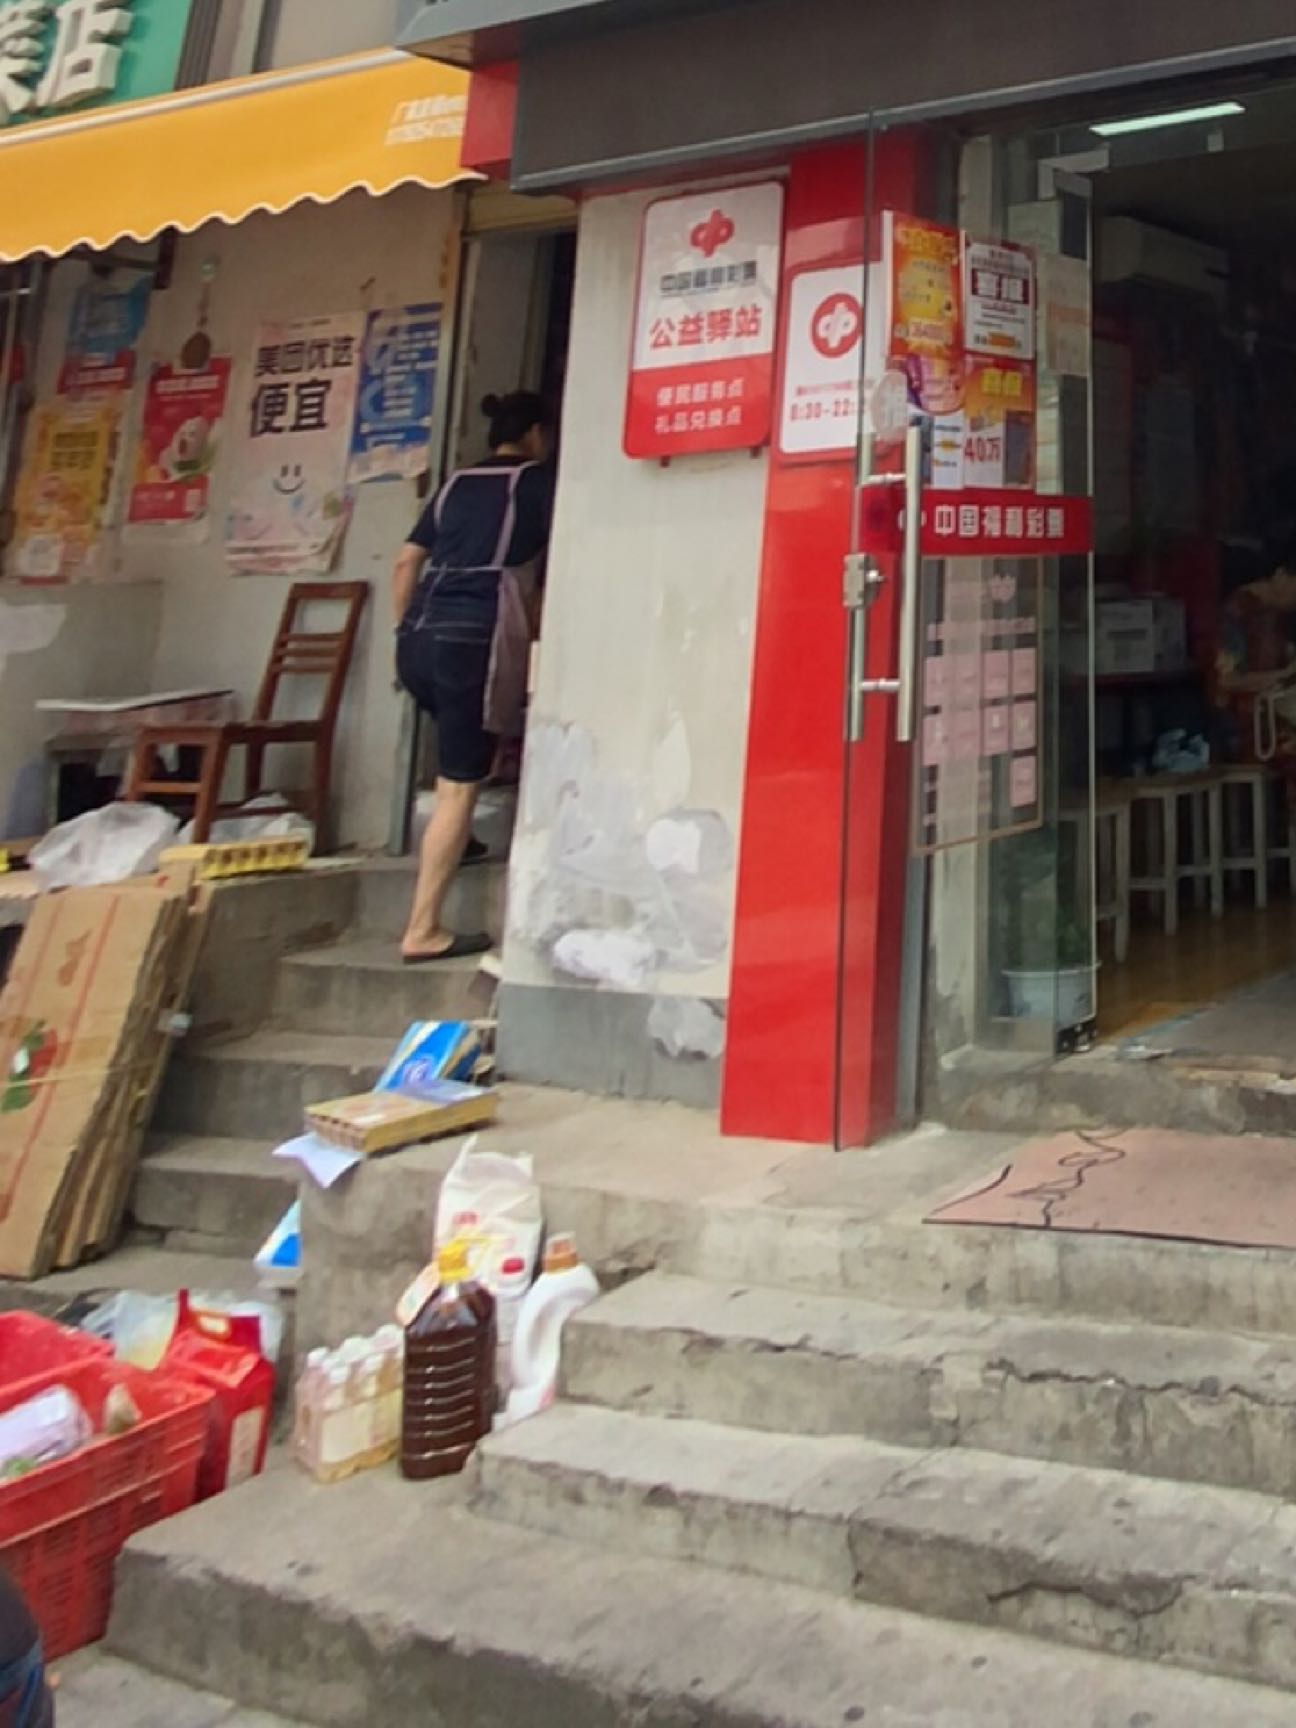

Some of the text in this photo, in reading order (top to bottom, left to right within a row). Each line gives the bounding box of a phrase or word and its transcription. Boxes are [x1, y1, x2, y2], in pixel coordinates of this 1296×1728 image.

[649, 305, 763, 351] 公益驿站
[250, 378, 333, 438] 便宜
[933, 504, 1065, 539] 中国福利彩票
